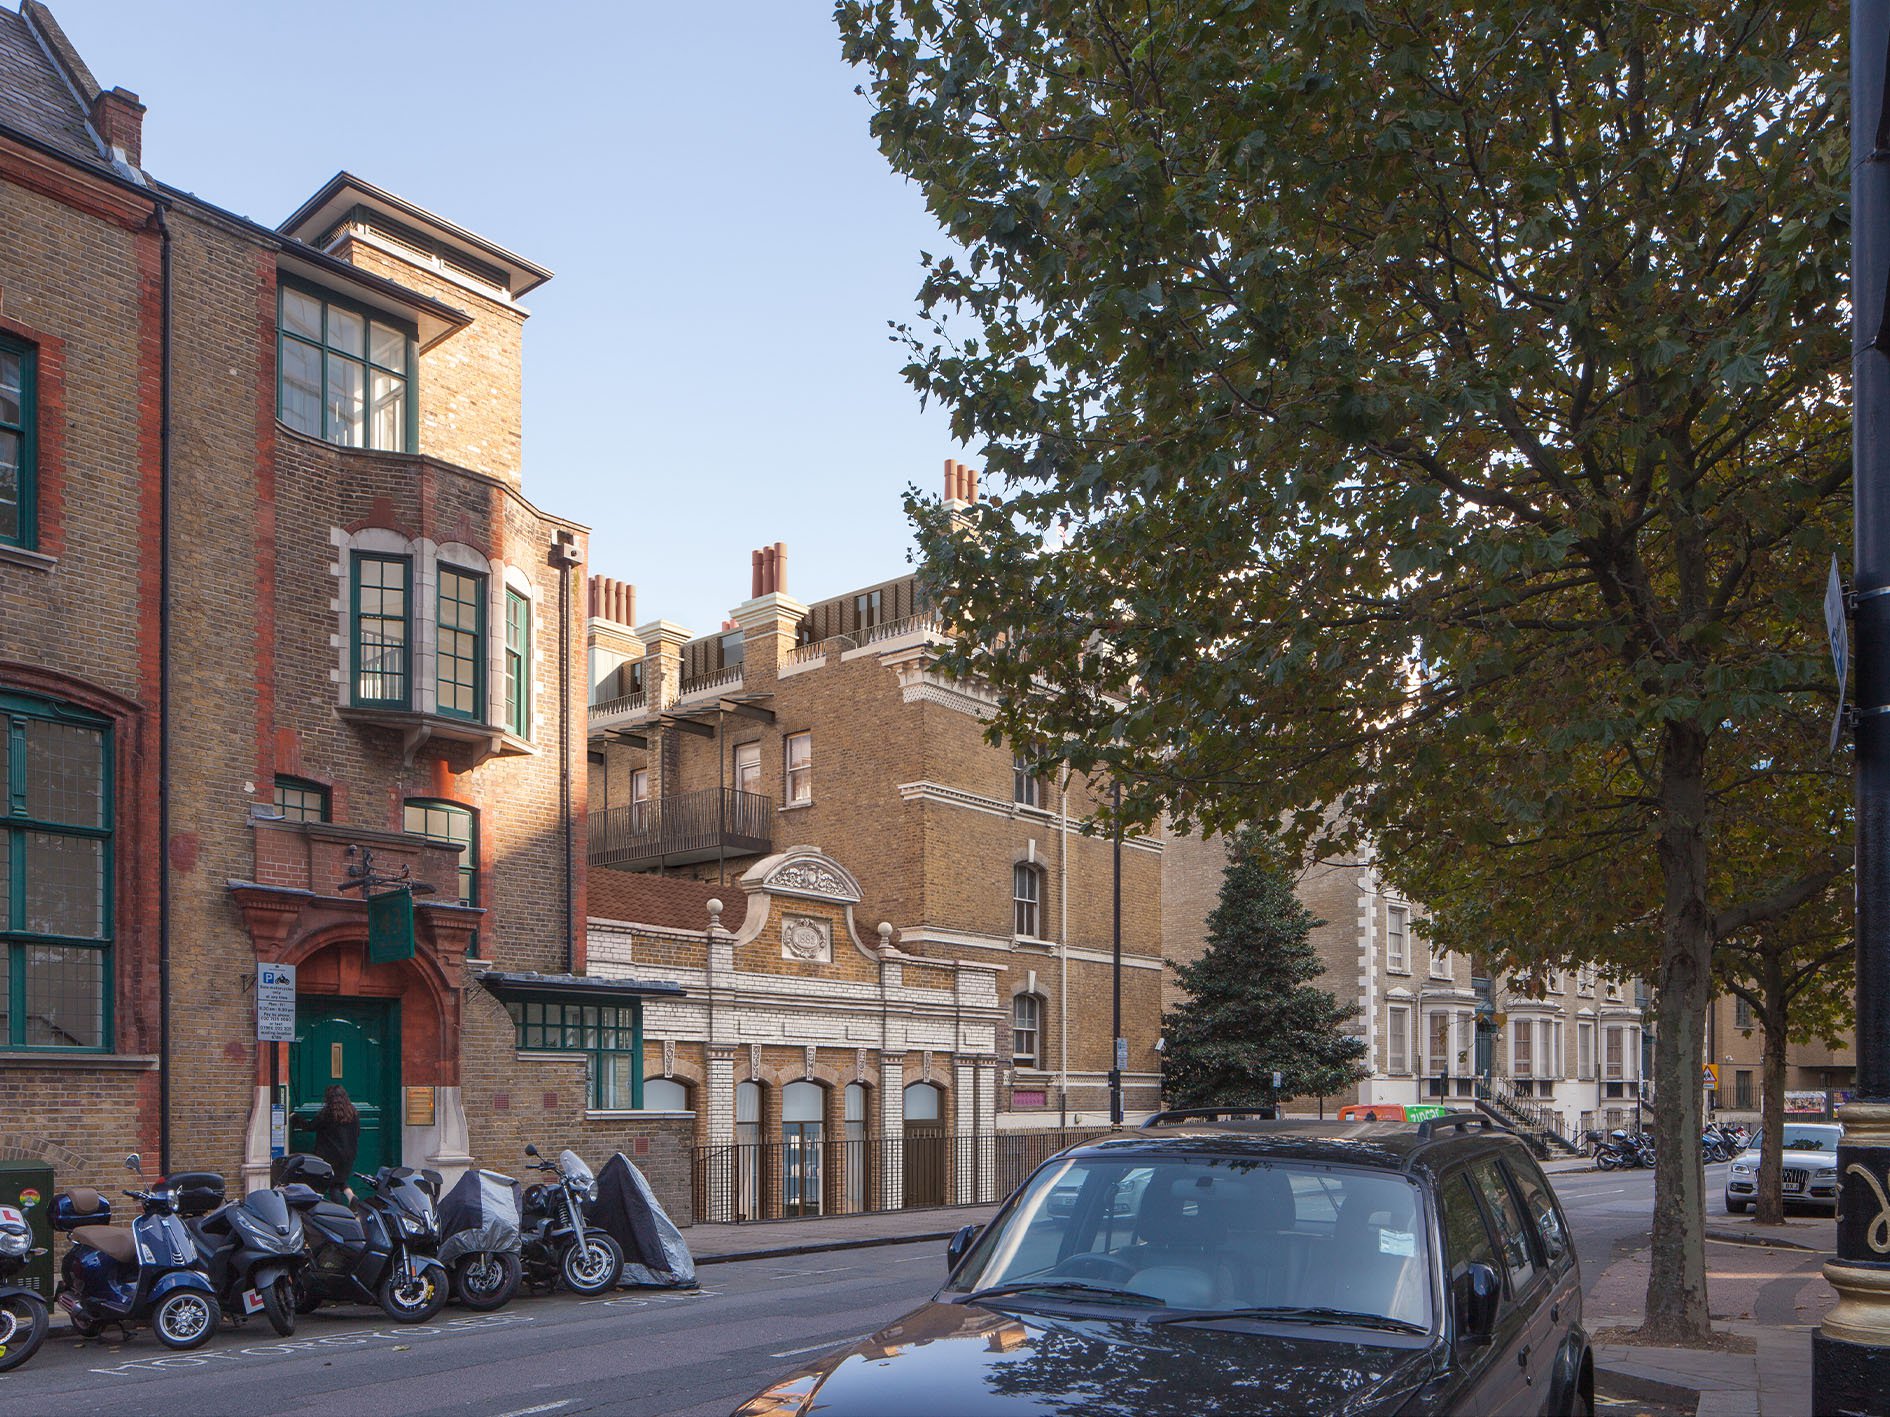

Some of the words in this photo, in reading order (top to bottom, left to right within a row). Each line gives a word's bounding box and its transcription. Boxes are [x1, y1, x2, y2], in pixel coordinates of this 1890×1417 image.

[265, 973, 273, 983] P
[3, 1210, 20, 1222] L
[249, 1293, 265, 1307] L
[88, 1314, 534, 1376] MOTORCYCLES
